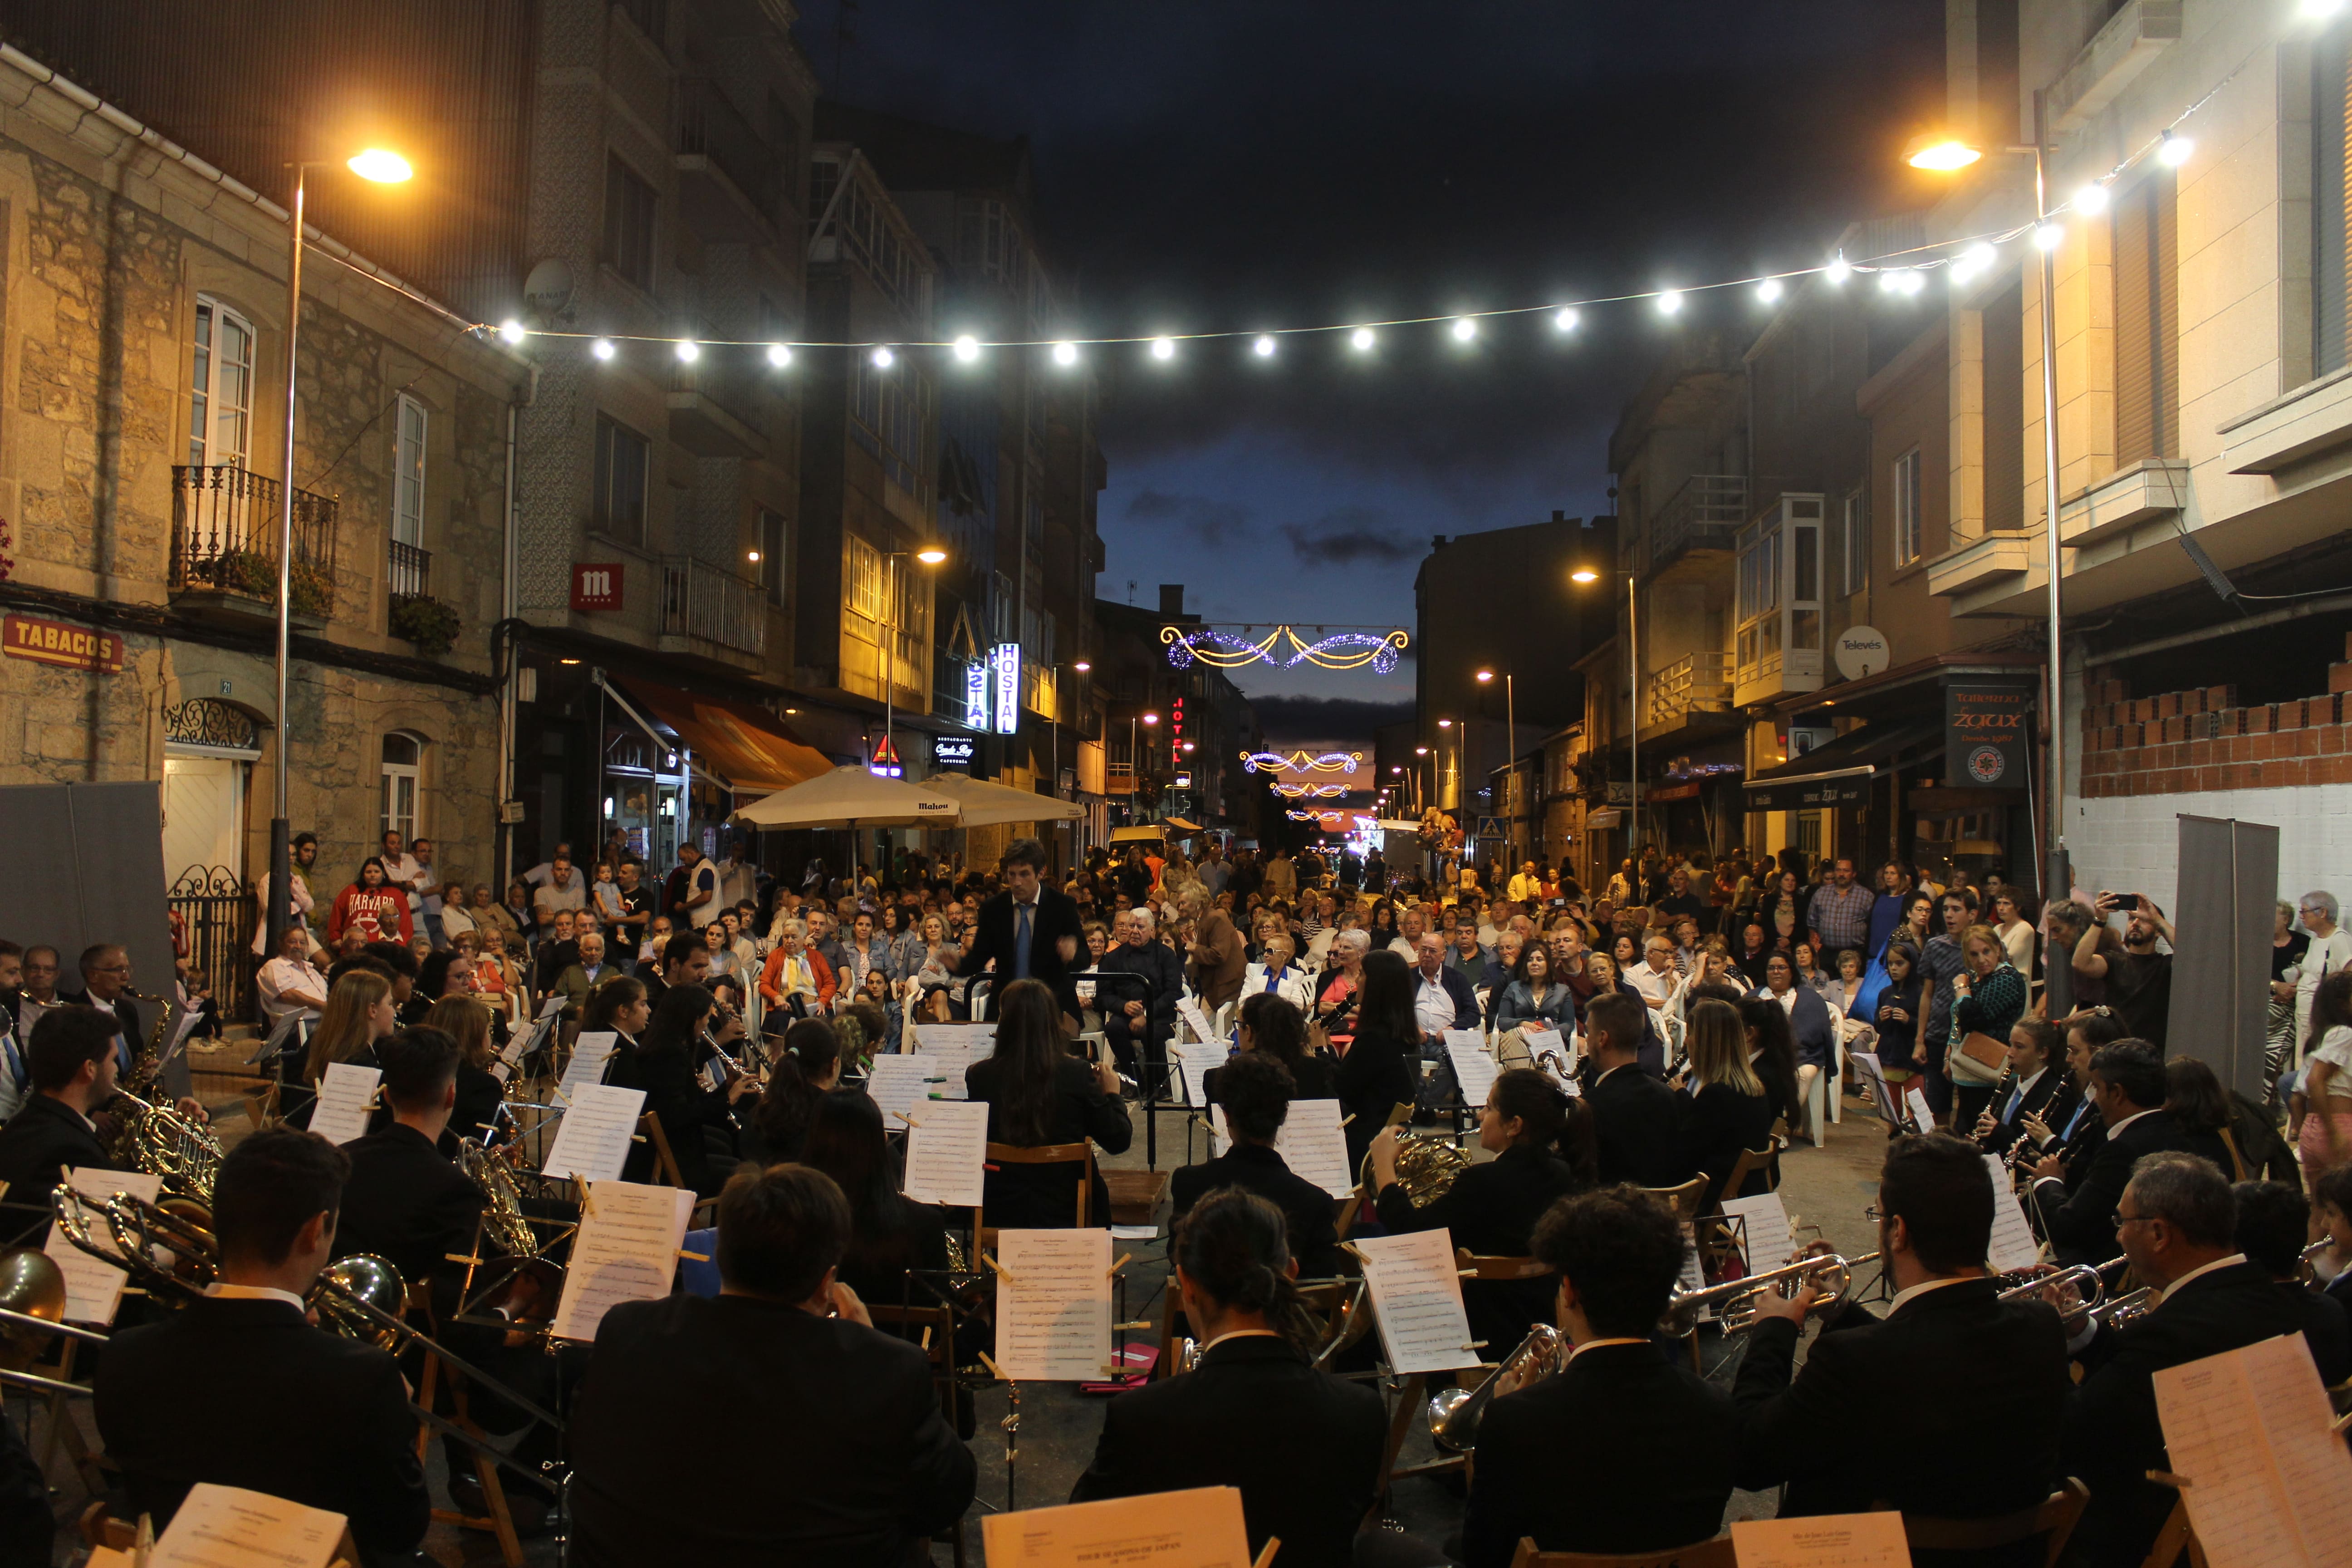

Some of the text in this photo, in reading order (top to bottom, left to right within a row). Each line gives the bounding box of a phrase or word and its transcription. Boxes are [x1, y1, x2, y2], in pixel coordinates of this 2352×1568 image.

[16, 621, 112, 659] TABACOS
[1842, 640, 1882, 650] Televés
[223, 682, 230, 693] 21
[1001, 644, 1014, 733] HOSTAL
[956, 744, 974, 757] Rey
[349, 894, 395, 916] HARVARD
